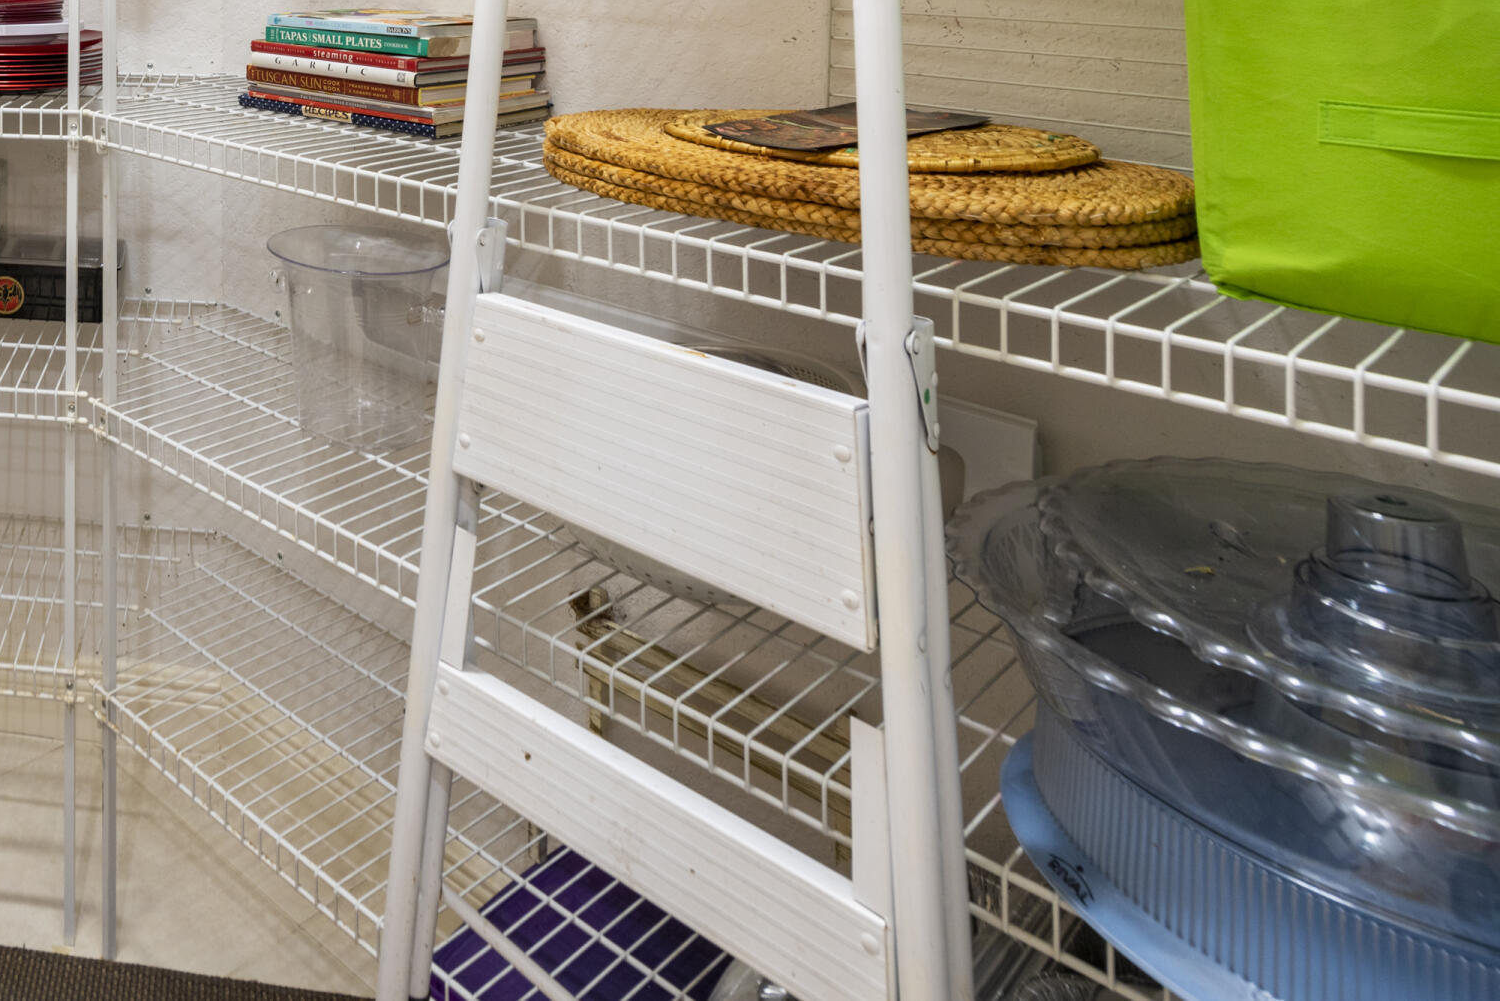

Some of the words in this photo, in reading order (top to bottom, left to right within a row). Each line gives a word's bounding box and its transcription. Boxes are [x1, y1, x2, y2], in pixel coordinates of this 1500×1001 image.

[279, 29, 308, 43] TAPAS
[311, 32, 344, 46] SMALL
[345, 35, 382, 49] PLATES
[313, 49, 354, 64] steaming
[253, 69, 298, 86] TUSCAN
[300, 75, 322, 89] SUN
[323, 85, 341, 93] BOOK
[304, 105, 349, 120] RECIPES
[1047, 857, 1090, 907] RIVAL
